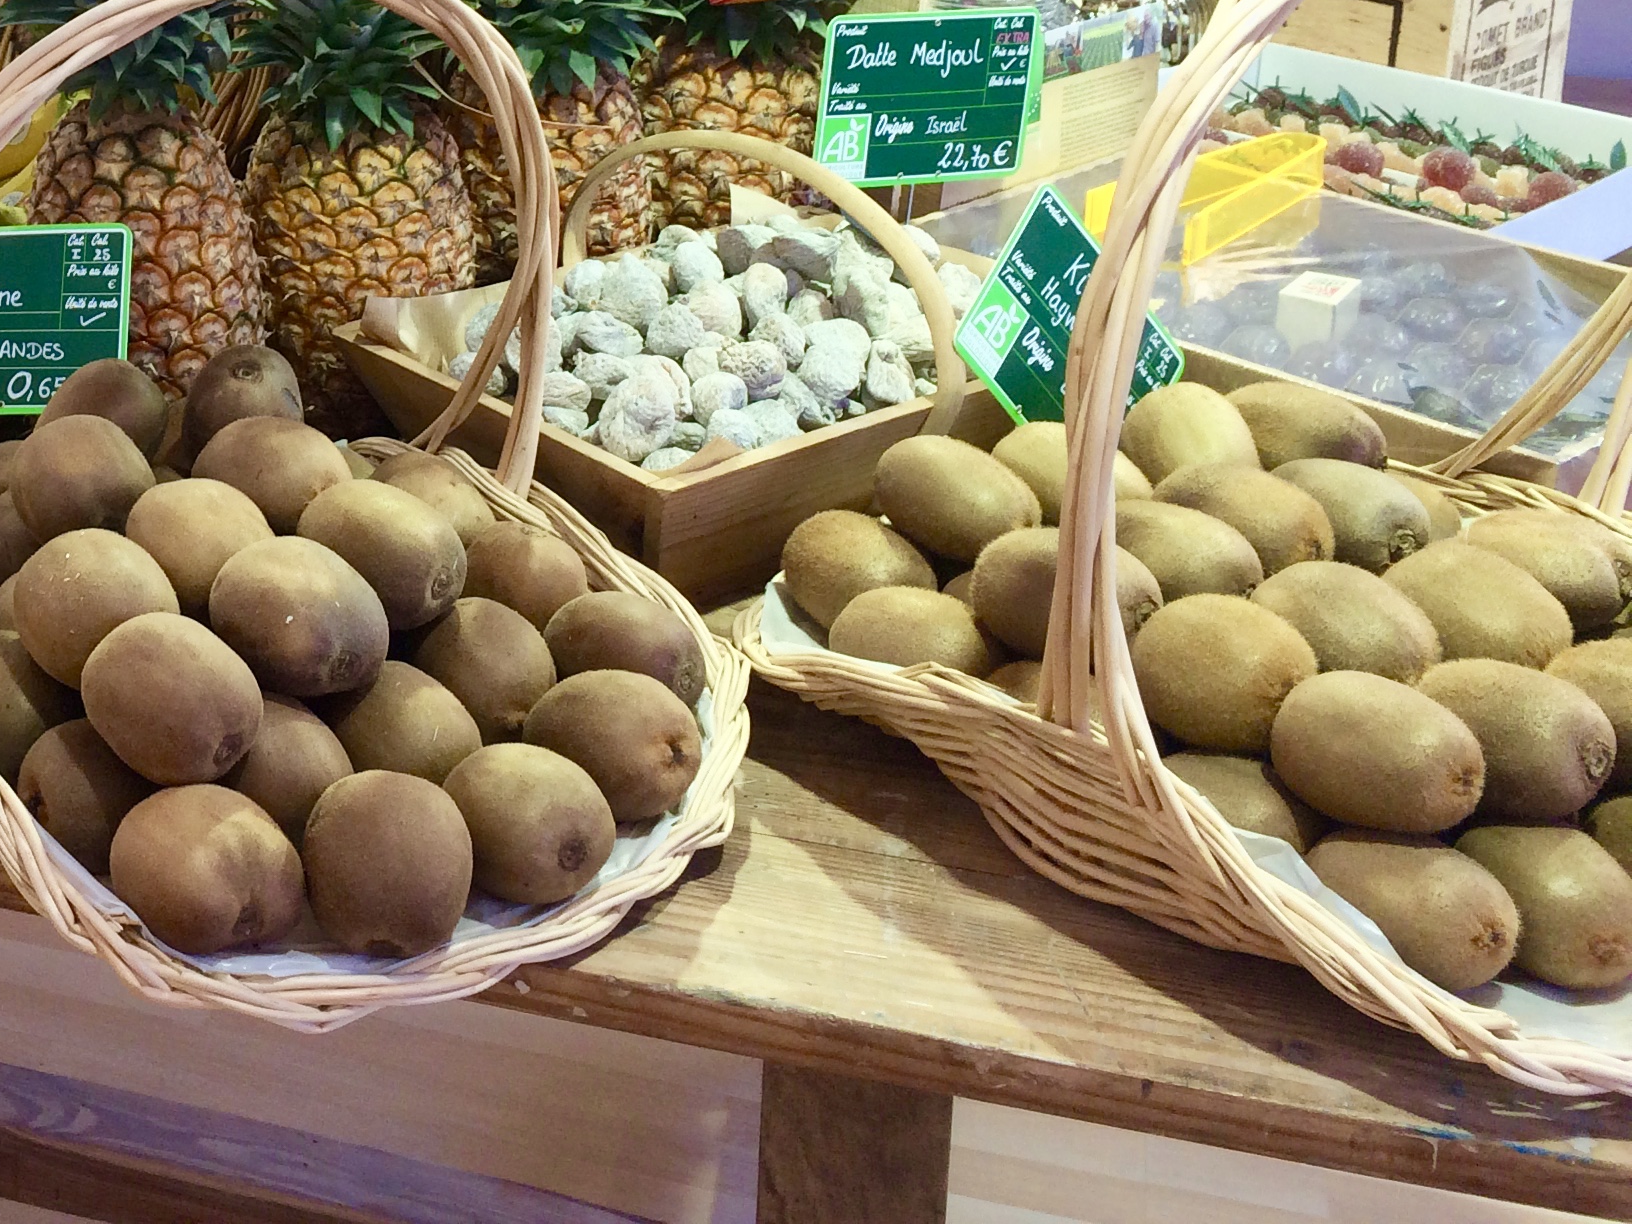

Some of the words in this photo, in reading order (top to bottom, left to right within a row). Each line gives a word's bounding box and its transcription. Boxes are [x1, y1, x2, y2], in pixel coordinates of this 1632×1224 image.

[836, 25, 868, 37] Produit
[846, 41, 897, 70] Datte
[910, 38, 984, 78] Medjoul
[1019, 58, 1026, 68] €
[831, 82, 860, 95] Variété
[875, 114, 915, 144] Origine
[925, 111, 968, 135] Israël
[822, 131, 859, 162] AB
[993, 140, 1013, 166] €
[1042, 195, 1068, 227] Produit
[93, 249, 110, 261] 25
[1011, 250, 1036, 281] Variété
[67, 264, 86, 277] Prix
[108, 279, 116, 289] €
[972, 304, 1011, 349] AB
[1022, 326, 1055, 372] Origine
